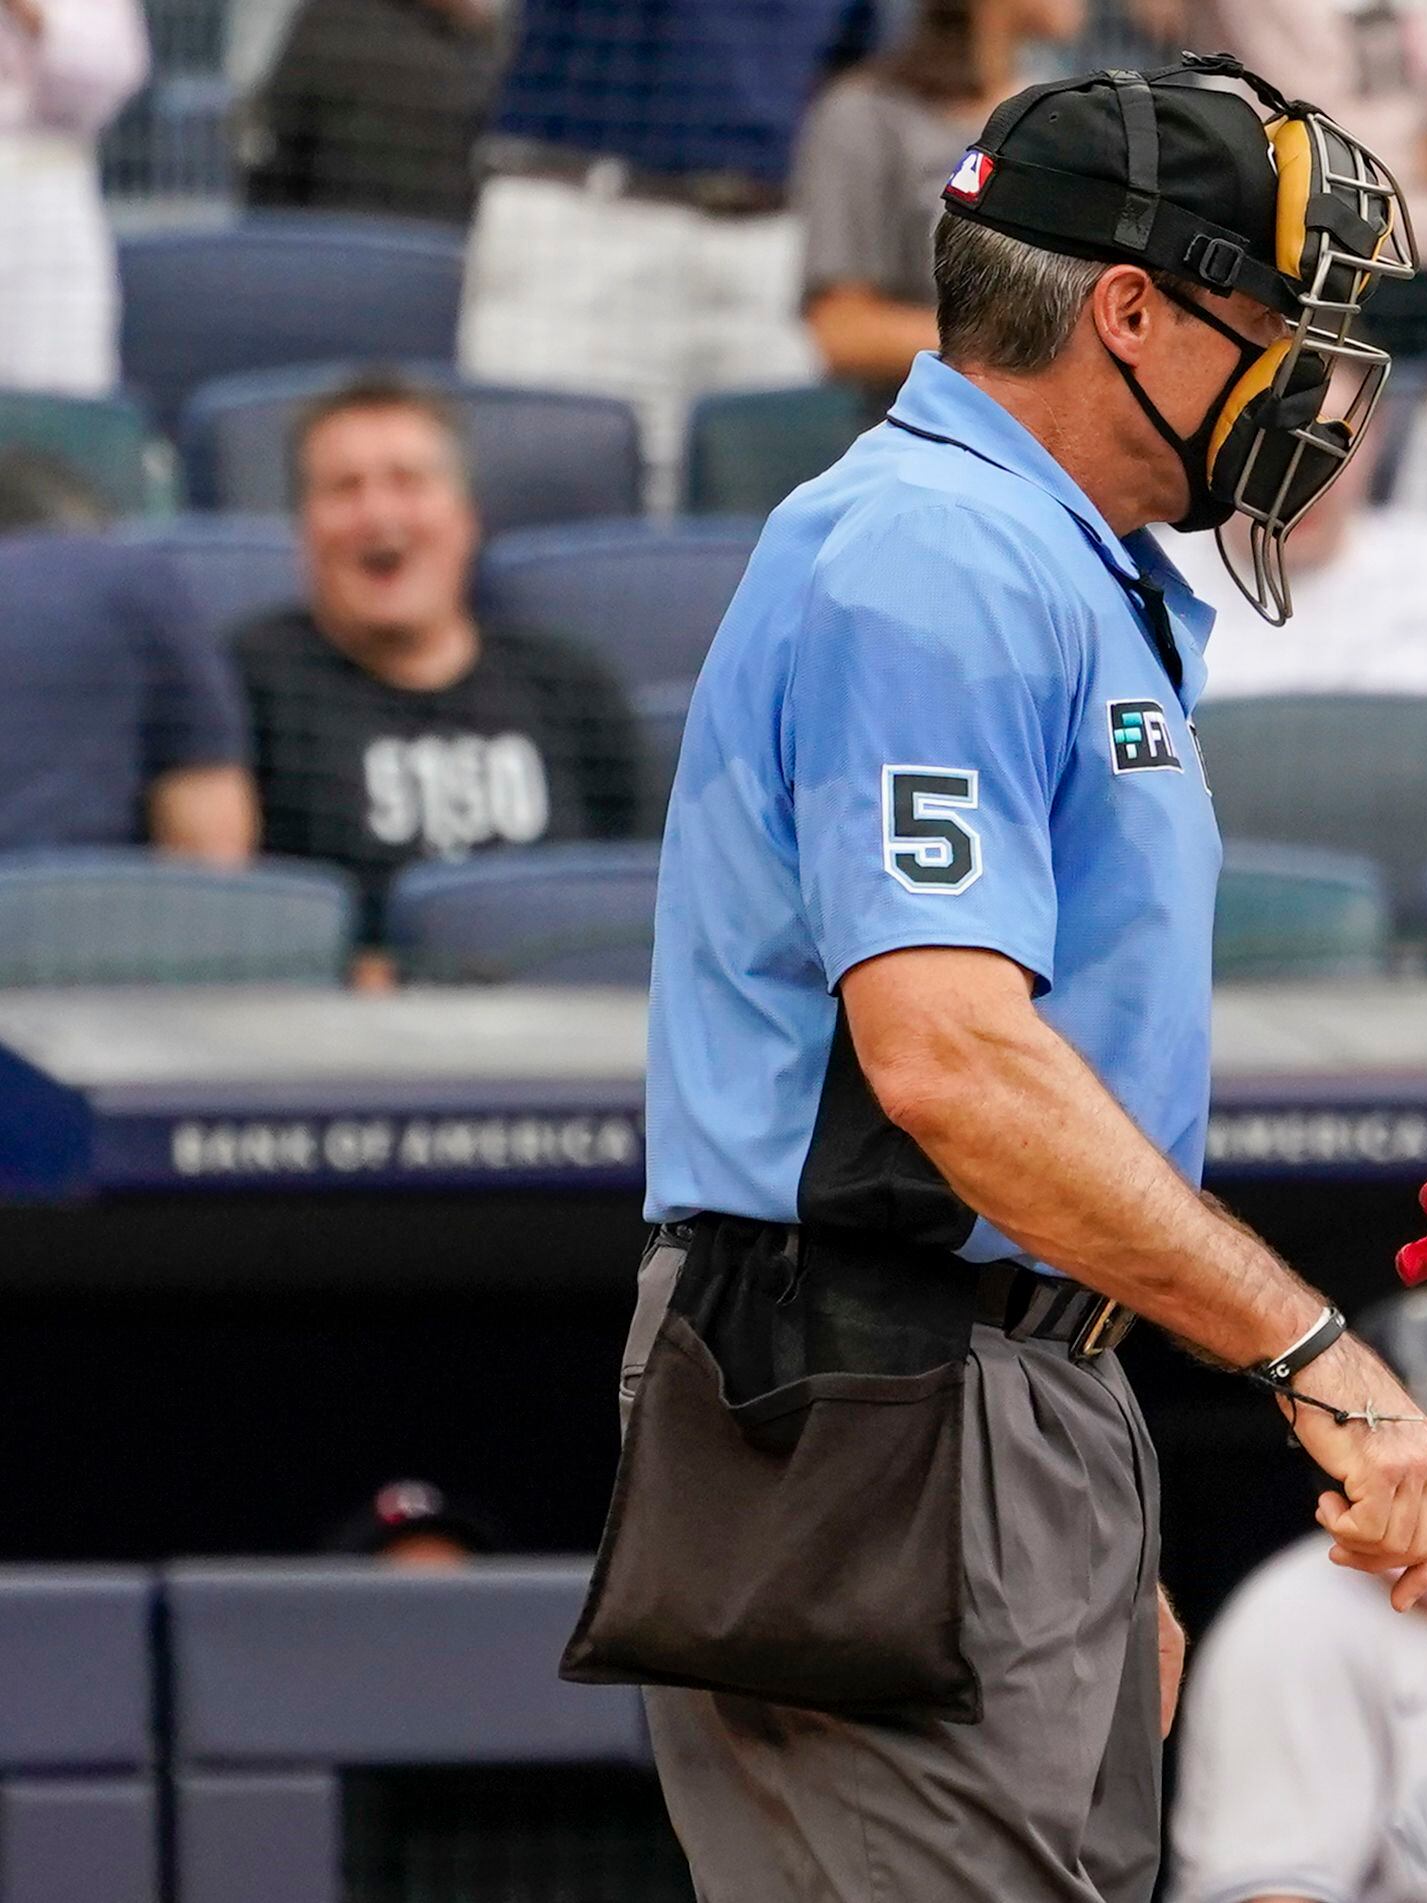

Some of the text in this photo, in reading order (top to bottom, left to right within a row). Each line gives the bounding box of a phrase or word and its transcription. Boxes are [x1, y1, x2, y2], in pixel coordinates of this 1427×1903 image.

[364, 733, 547, 843] 5150
[881, 763, 984, 896] 5
[172, 1116, 636, 1176] BANK OF AMERICA
